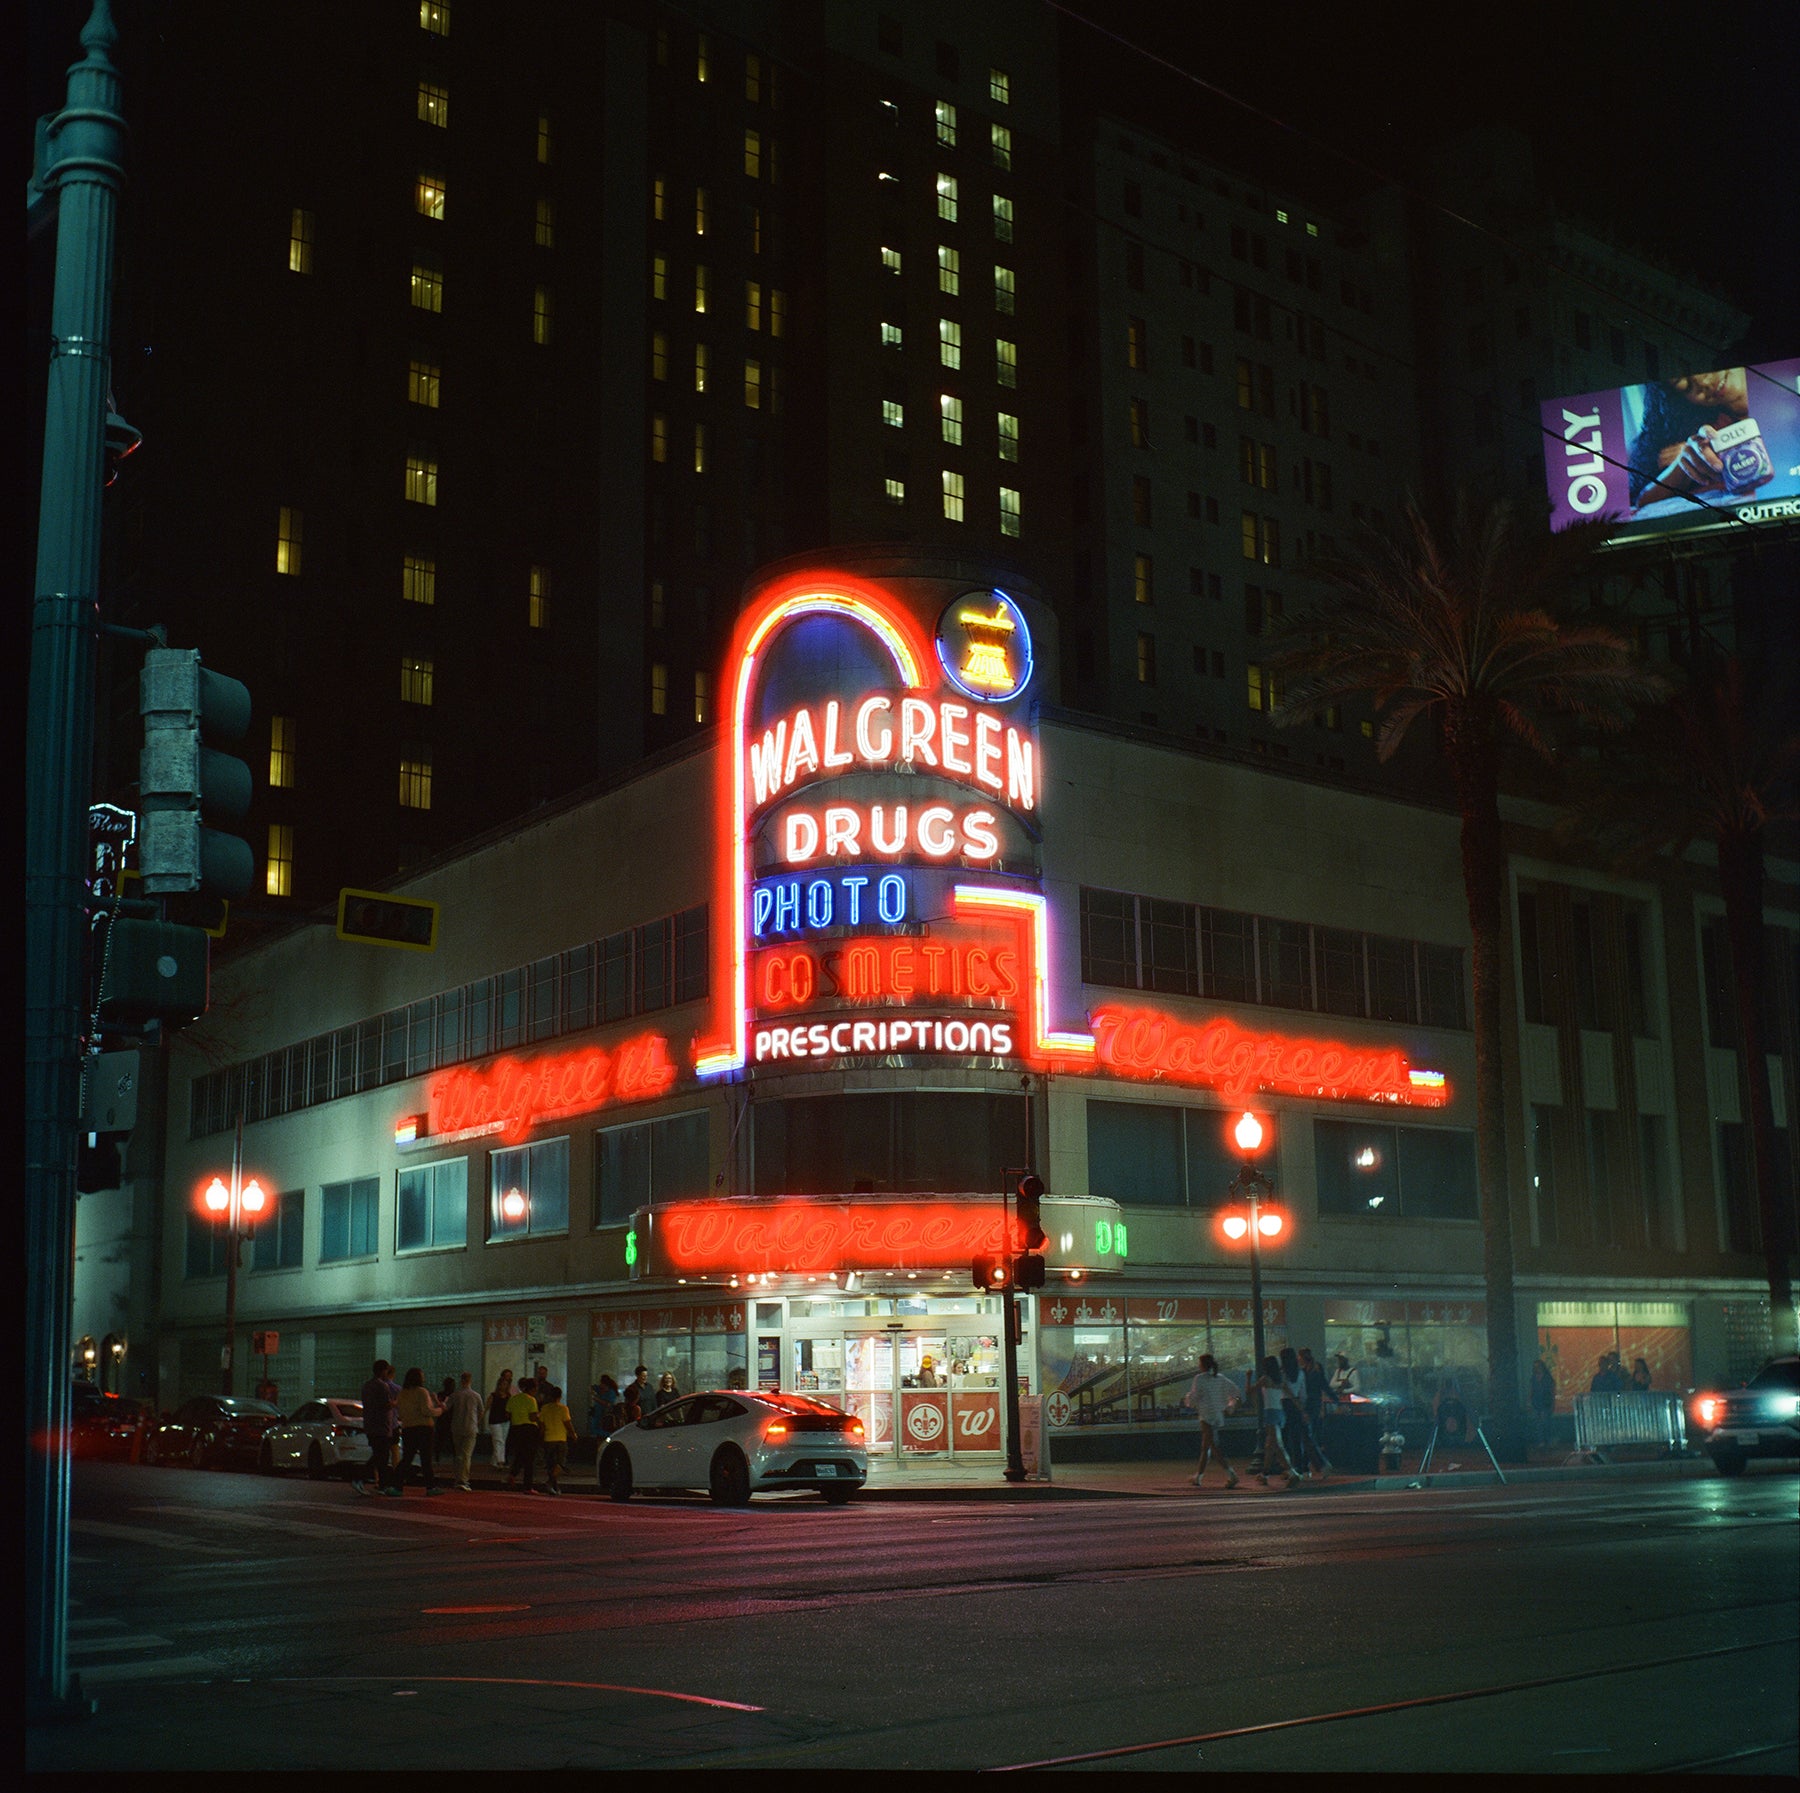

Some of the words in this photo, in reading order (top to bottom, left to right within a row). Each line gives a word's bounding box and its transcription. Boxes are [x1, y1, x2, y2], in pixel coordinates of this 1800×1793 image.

[1720, 426, 1747, 443] OLLY
[750, 696, 1034, 811] WALGREEN
[89, 812, 128, 832] The
[785, 805, 999, 863] DRUGS
[754, 874, 906, 936] PHOTO
[765, 946, 1019, 1004] COSMETICS
[755, 1021, 1013, 1062] PRESCRIPTIONS
[1100, 1013, 1412, 1097] Walgreens
[957, 1407, 996, 1437] W
